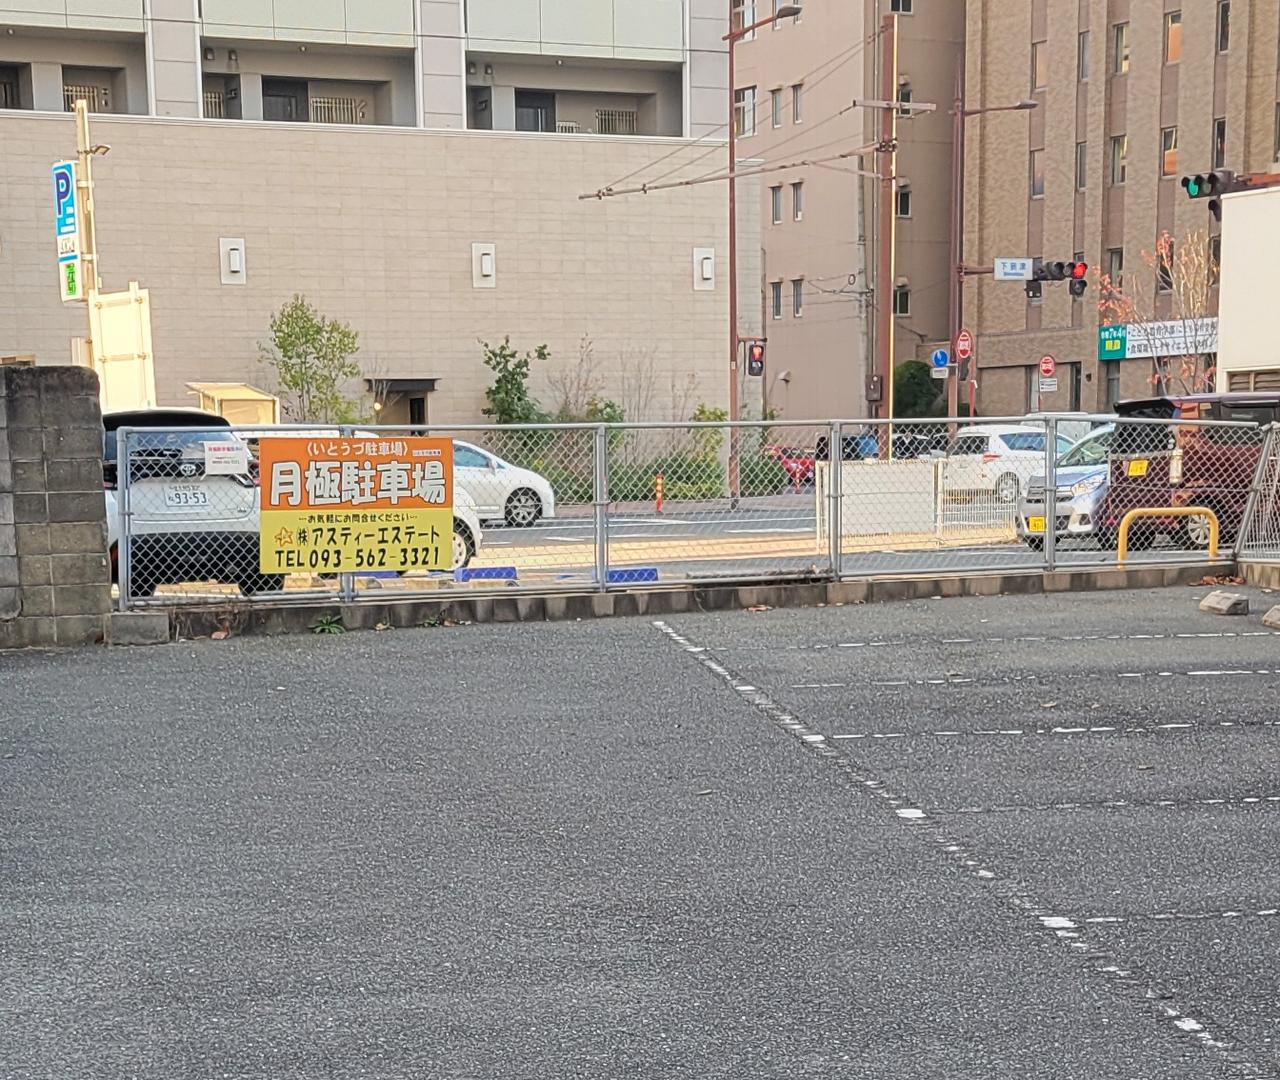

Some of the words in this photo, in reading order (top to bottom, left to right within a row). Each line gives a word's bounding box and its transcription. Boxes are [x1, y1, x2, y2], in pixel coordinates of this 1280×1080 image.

[55, 171, 71, 216] P
[270, 460, 446, 506] 月極駐車場
